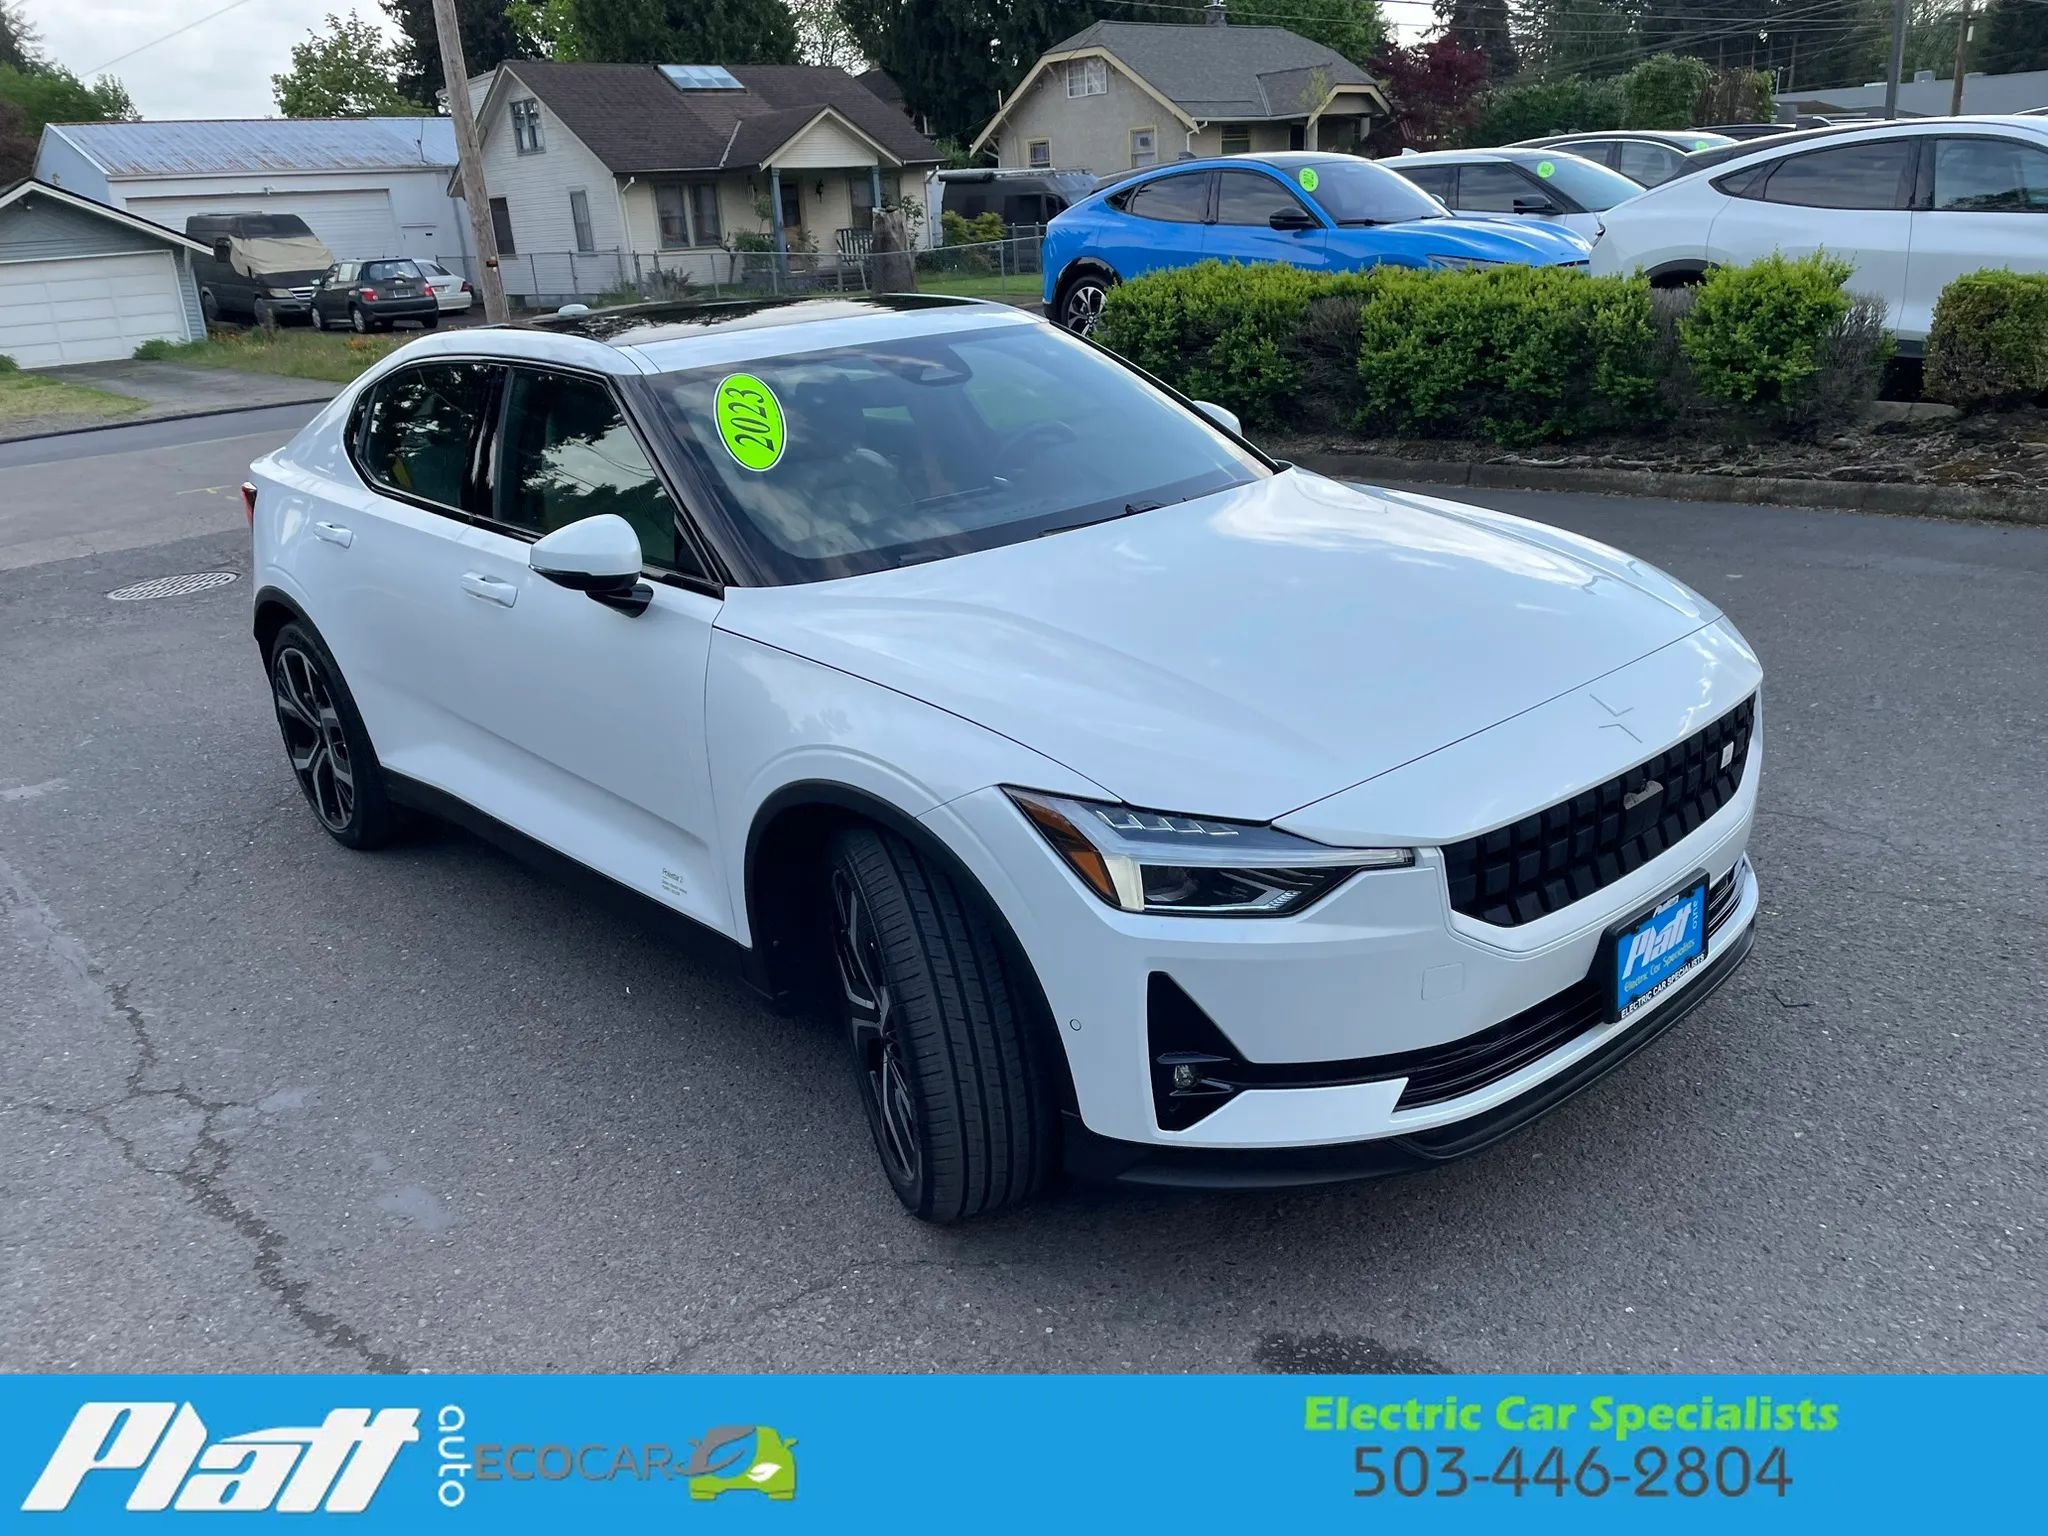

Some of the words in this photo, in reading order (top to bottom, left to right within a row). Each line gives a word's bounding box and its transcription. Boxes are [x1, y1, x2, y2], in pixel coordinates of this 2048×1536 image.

[724, 387, 775, 452] 2023
[1621, 902, 1692, 980] Platt
[1621, 991, 1652, 1018] ELECTRIC
[1652, 980, 1667, 996] CAR
[1667, 953, 1705, 986] SPECIALISTS
